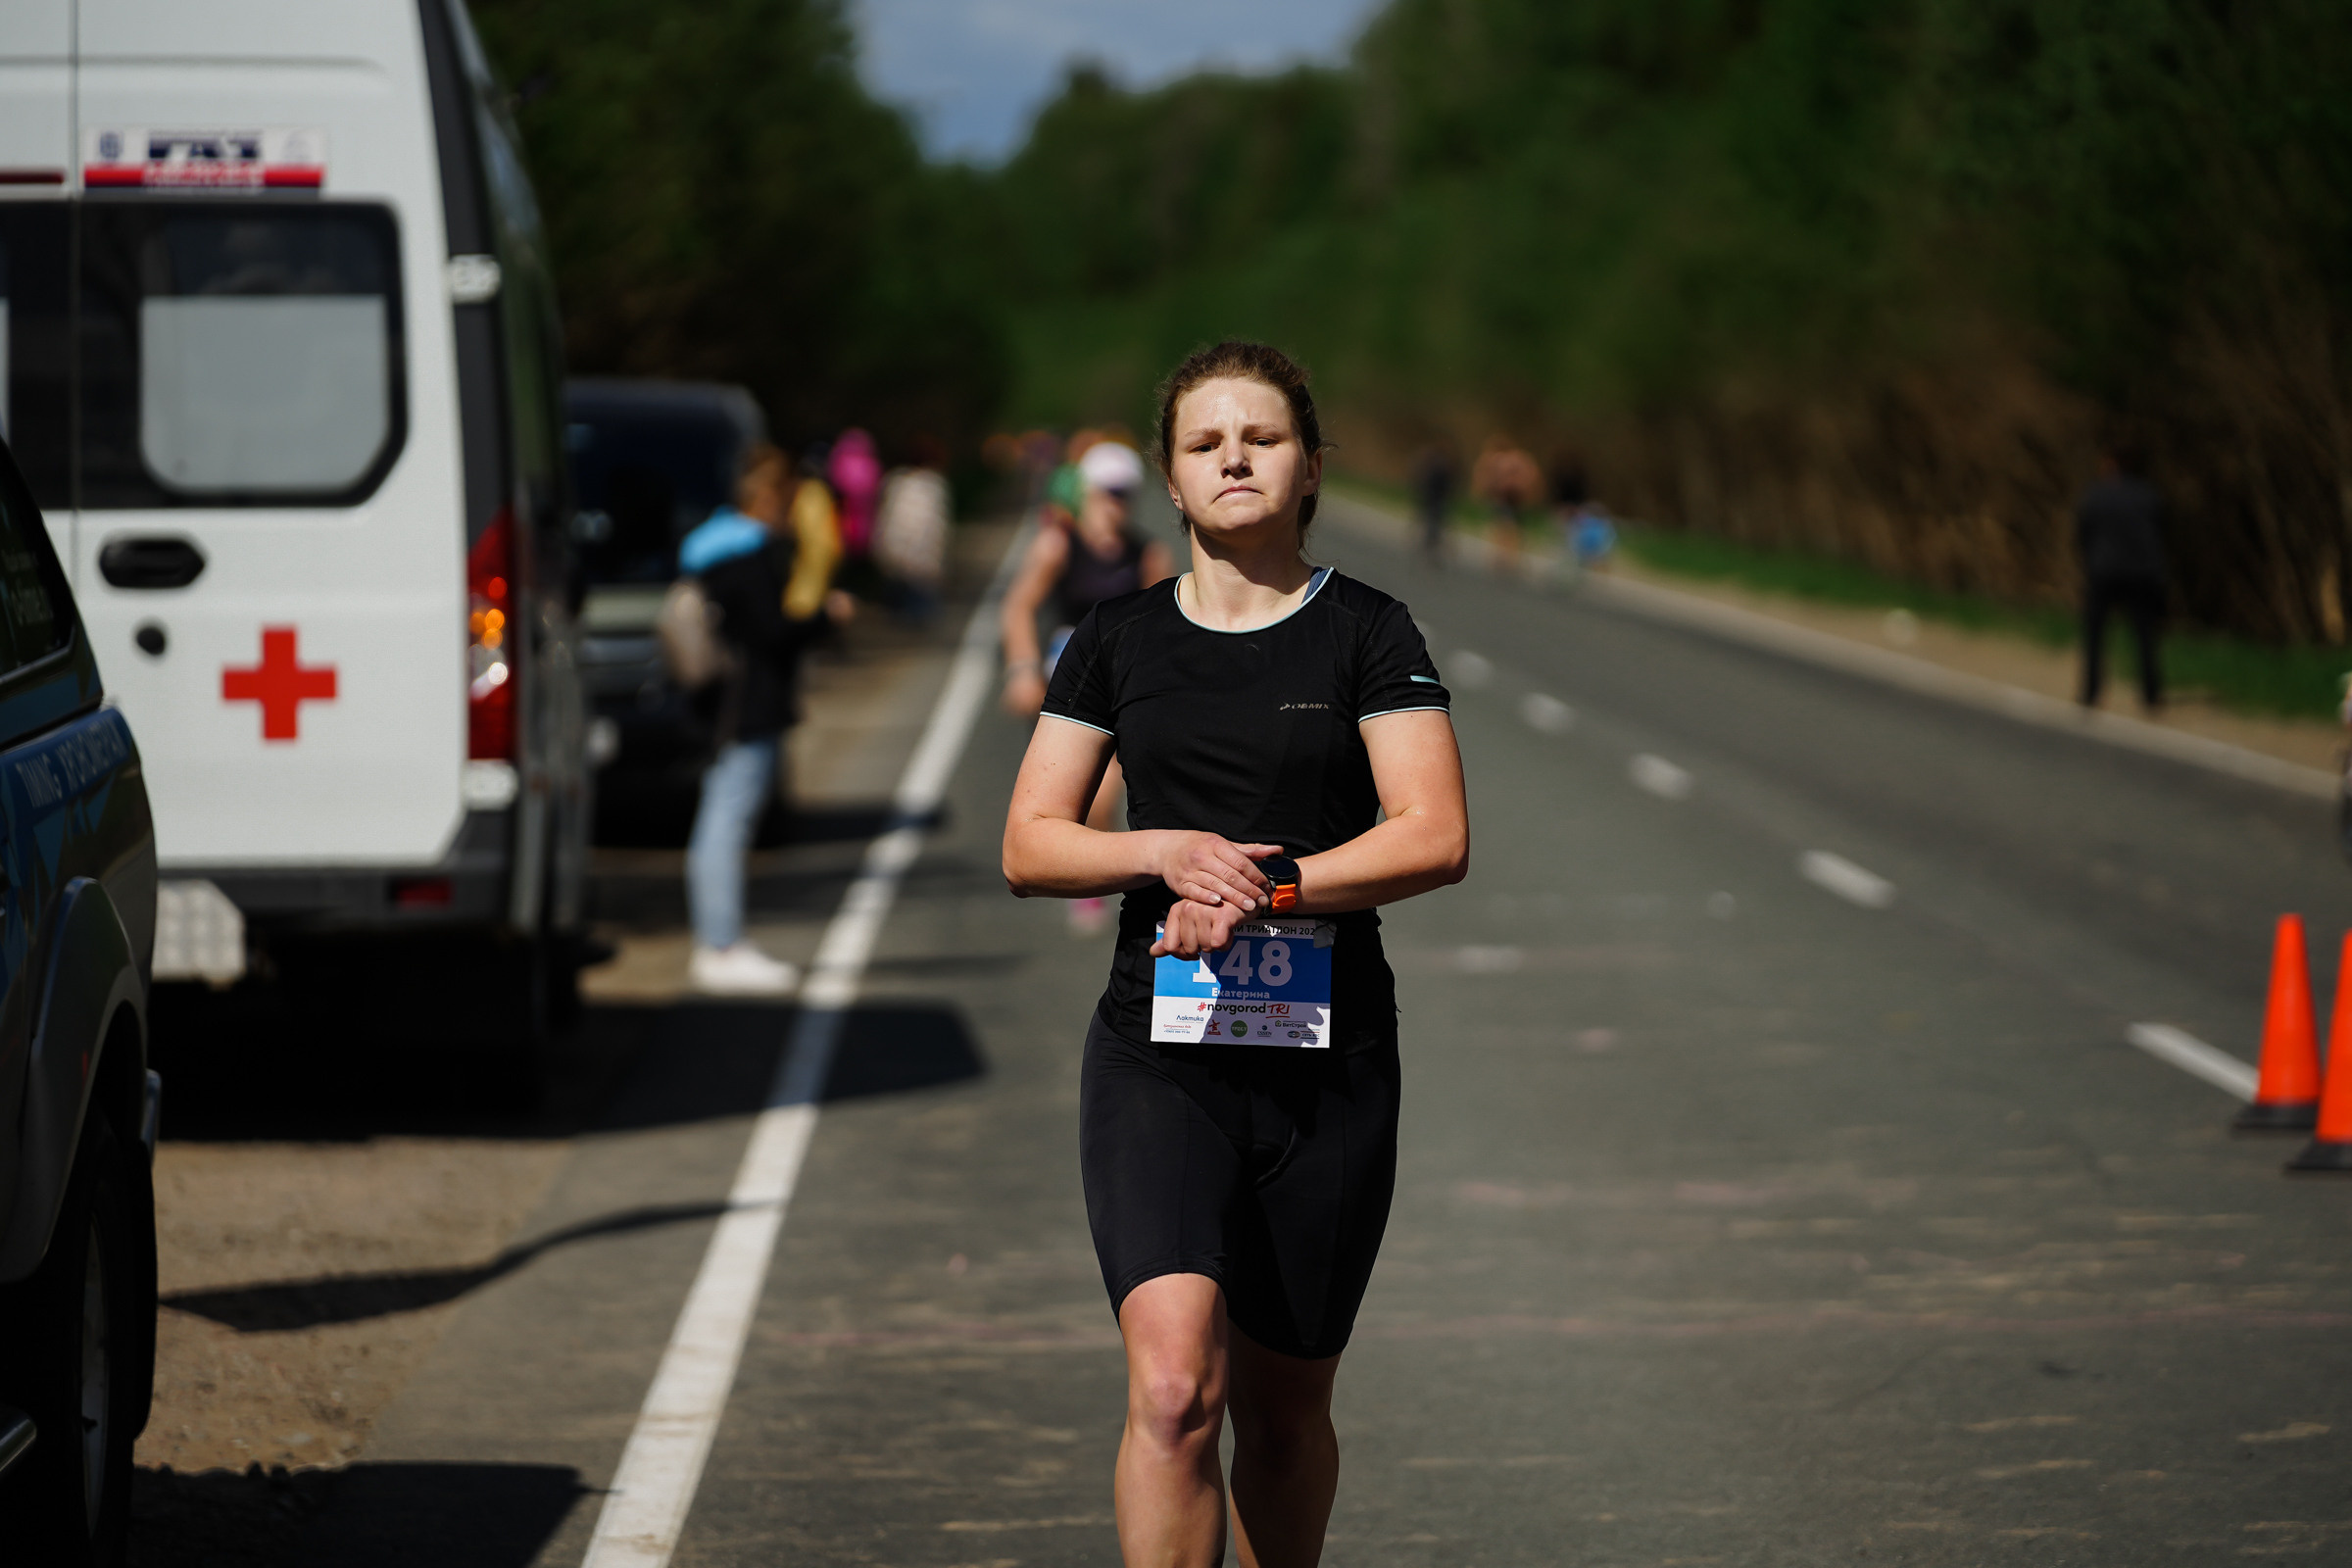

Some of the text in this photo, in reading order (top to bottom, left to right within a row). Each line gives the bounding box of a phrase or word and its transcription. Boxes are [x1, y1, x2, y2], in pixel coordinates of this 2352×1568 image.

[1246, 924, 1298, 935] ТРИАТЛОН
[1298, 927, 1315, 936] 202
[1193, 940, 1293, 986] 148
[1211, 987, 1271, 1001] Екатерина
